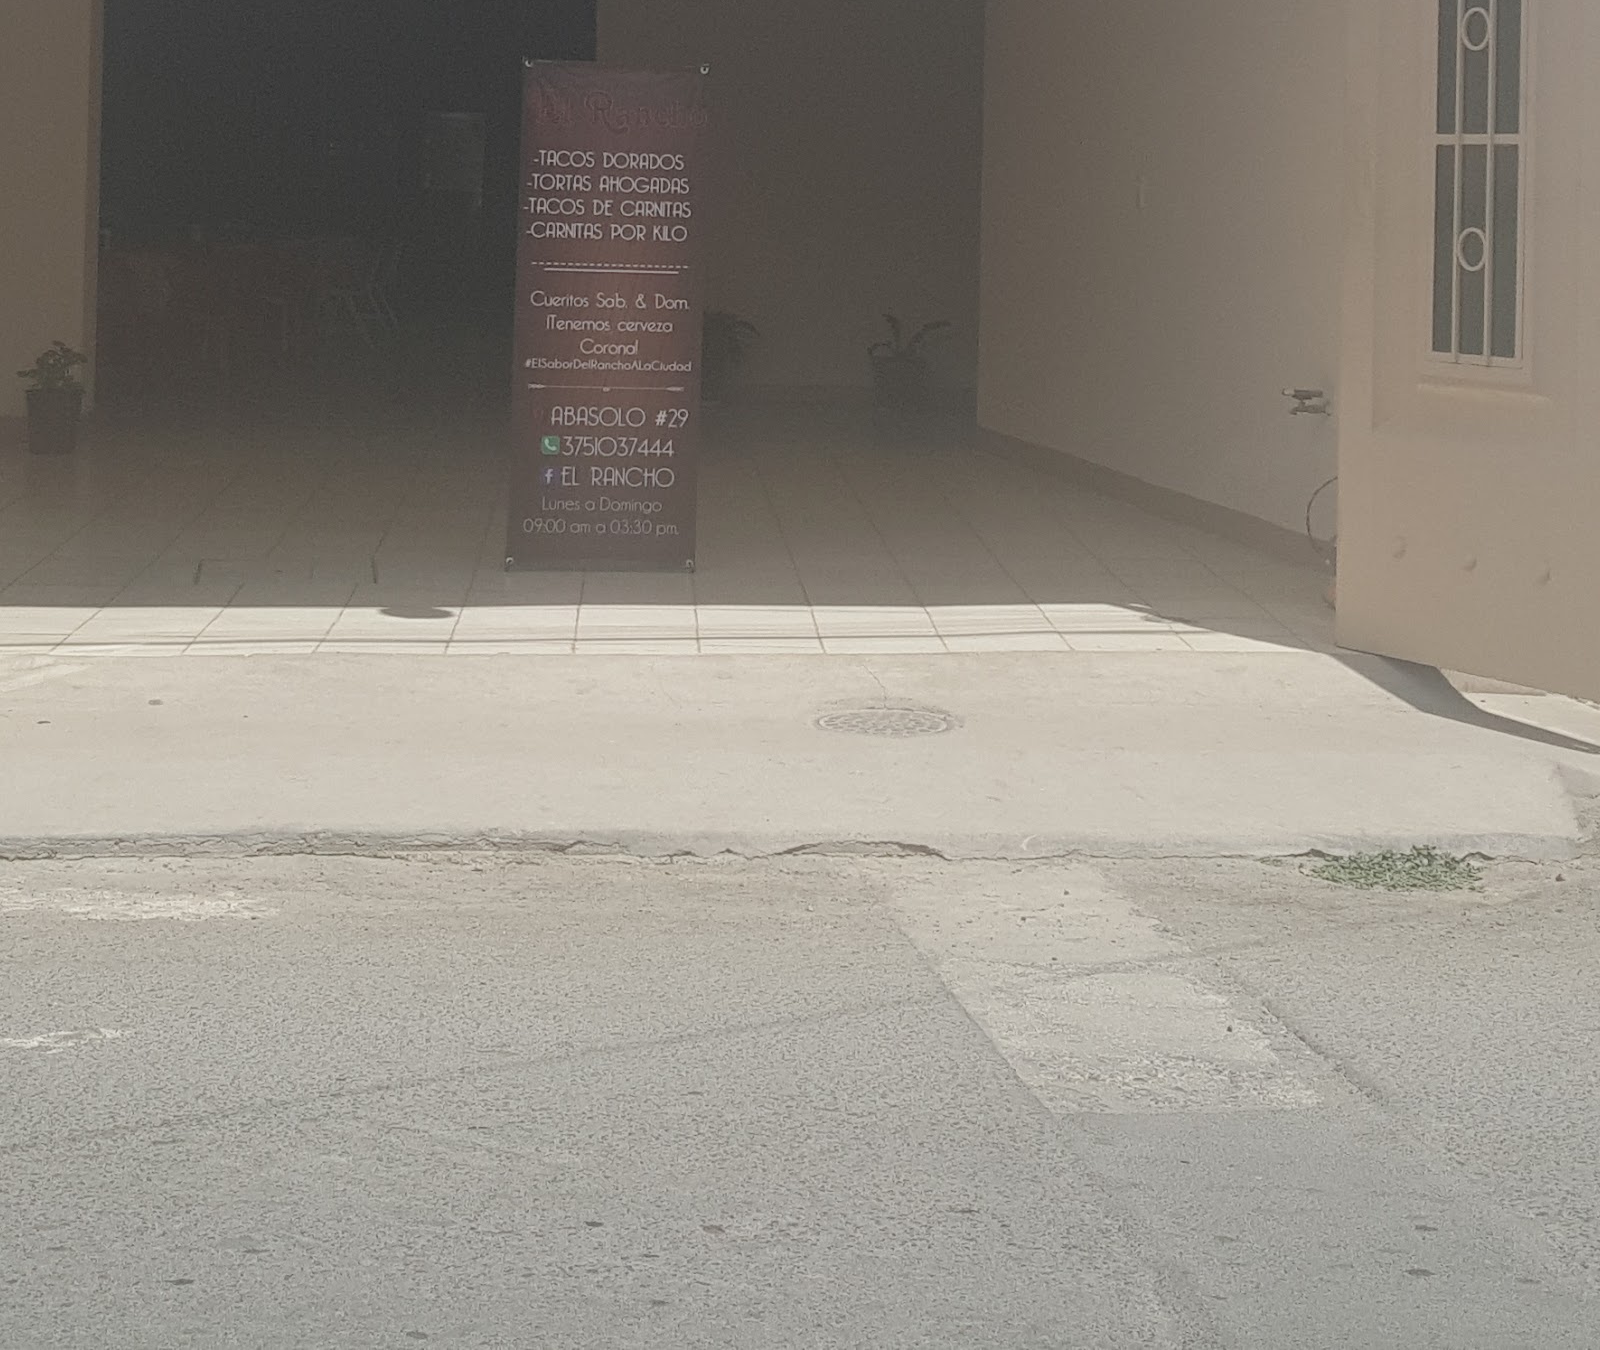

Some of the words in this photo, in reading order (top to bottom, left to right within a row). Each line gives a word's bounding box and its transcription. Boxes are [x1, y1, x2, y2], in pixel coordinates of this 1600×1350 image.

[533, 150, 596, 168] -TACOS
[603, 152, 685, 171] DORADOS
[526, 173, 592, 192] -TORTAS
[599, 176, 690, 195] AHOGADAS
[523, 197, 585, 215] -TACOS
[593, 199, 613, 217] DE
[620, 200, 692, 218] CARNITAS
[526, 221, 603, 240] -CARNITAS
[611, 224, 647, 241] POR
[653, 225, 688, 243] KILO
[530, 290, 589, 308] Cueritos
[635, 293, 647, 309] &
[617, 320, 673, 333] cerveza
[551, 405, 646, 427] ABASOLO
[655, 408, 690, 428] #29
[562, 436, 675, 457] 3751037444
[561, 466, 580, 486] EL
[591, 466, 675, 488] RANCHO
[541, 497, 581, 511] Lunes
[584, 501, 596, 512] a
[600, 496, 663, 514] Domingo
[523, 518, 566, 534] 09:00
[569, 523, 591, 534] am
[595, 523, 606, 534] a
[609, 519, 652, 535] 03:30
